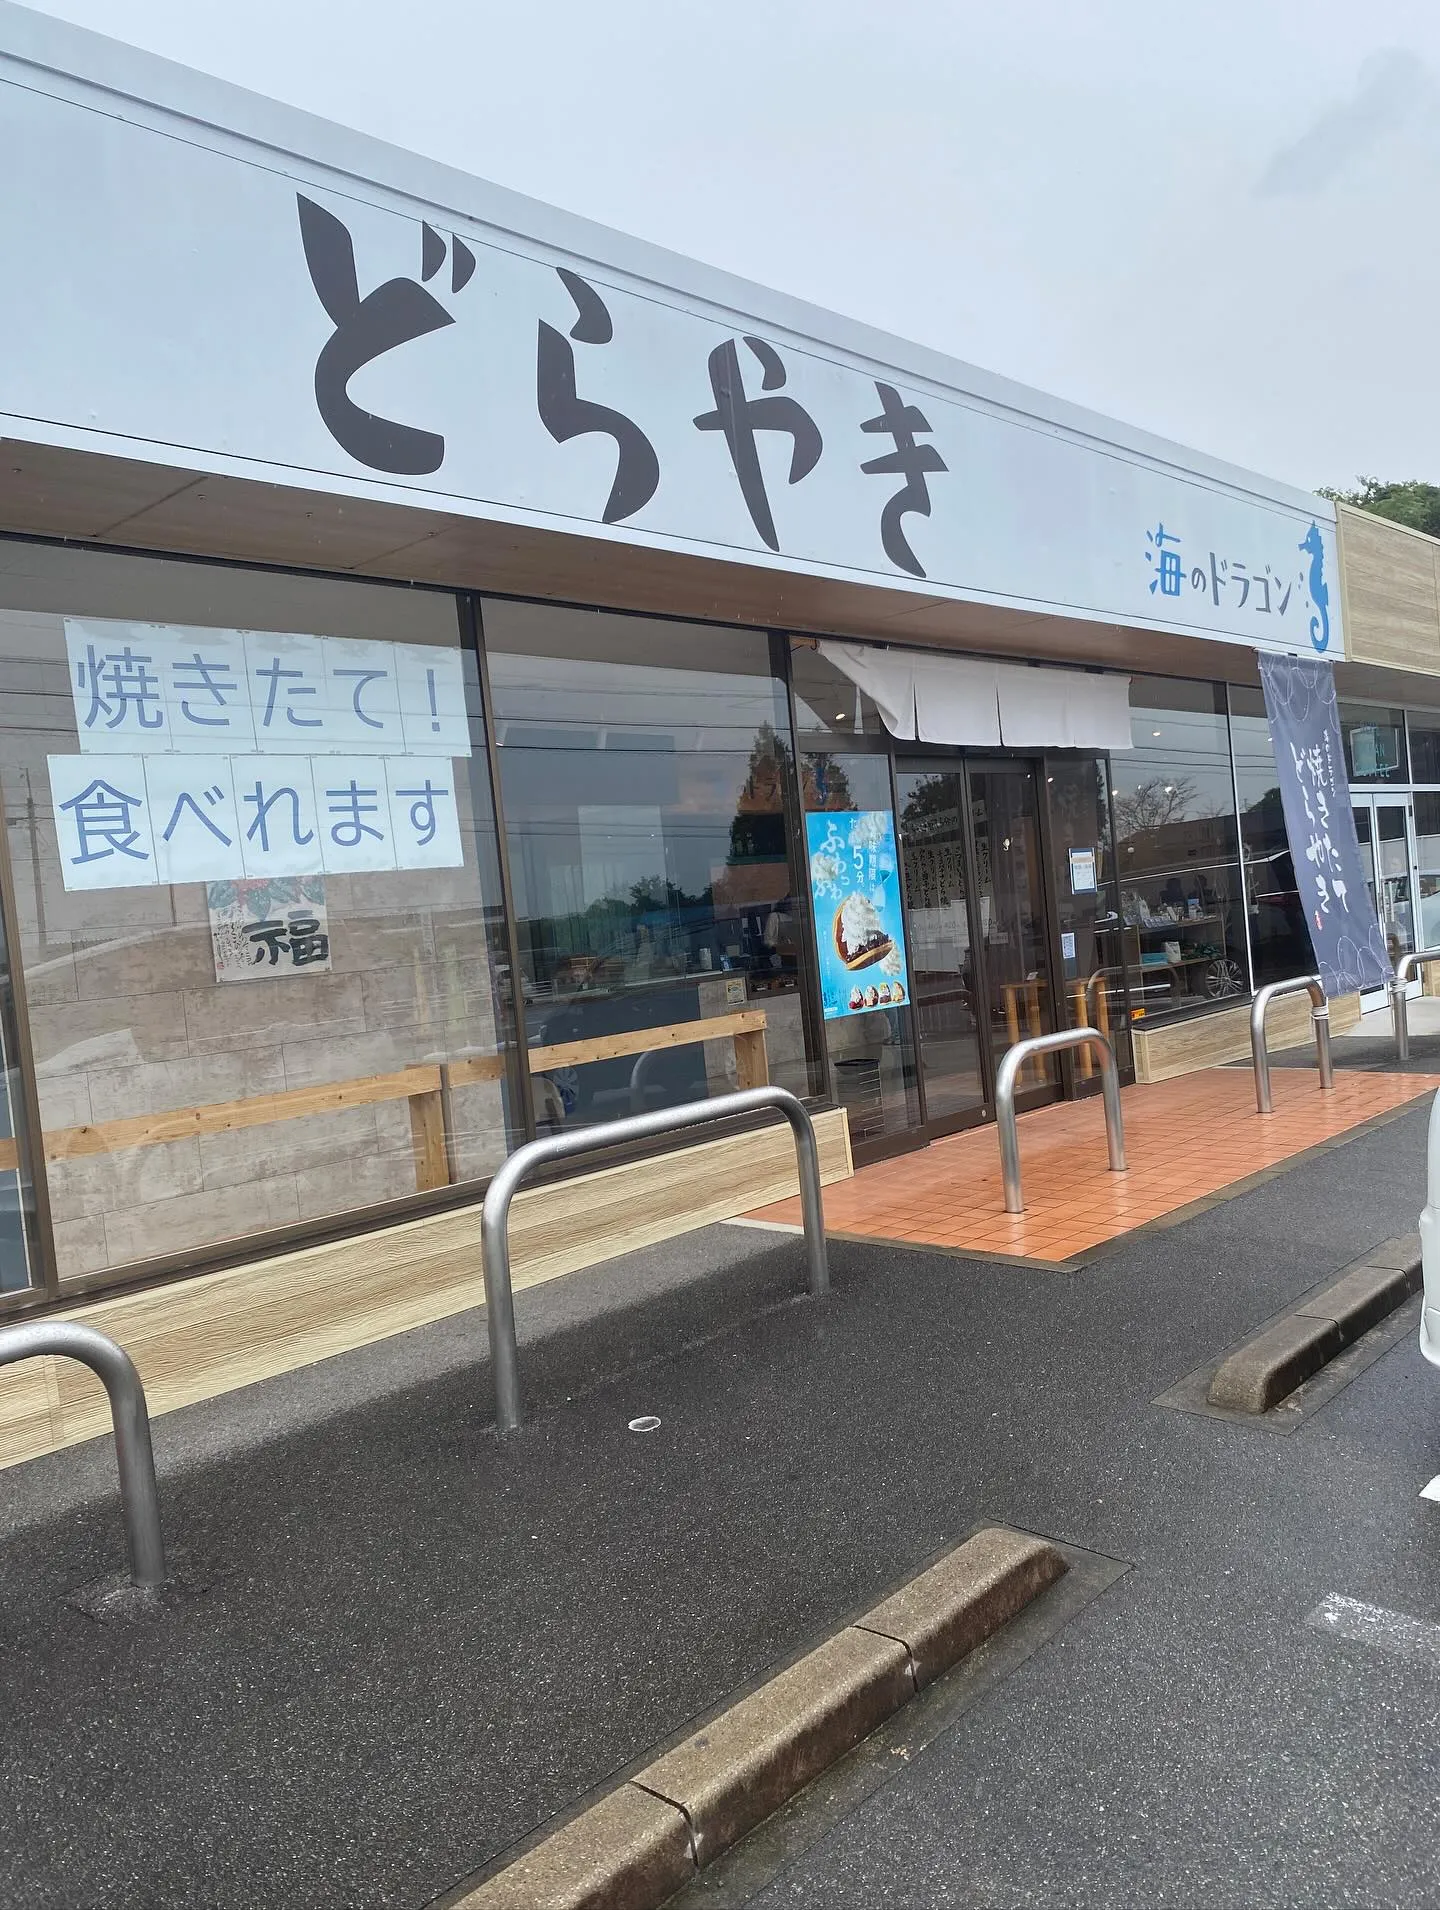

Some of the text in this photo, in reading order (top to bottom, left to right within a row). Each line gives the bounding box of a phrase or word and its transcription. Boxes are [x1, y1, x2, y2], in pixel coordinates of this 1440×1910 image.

[296, 192, 949, 578] どらやき
[1144, 521, 1296, 617] 海のドラゴン
[58, 778, 450, 866] 食べれます
[1289, 741, 1330, 914] どらやき
[1306, 743, 1350, 913] 焼きたて
[242, 910, 329, 966] 福
